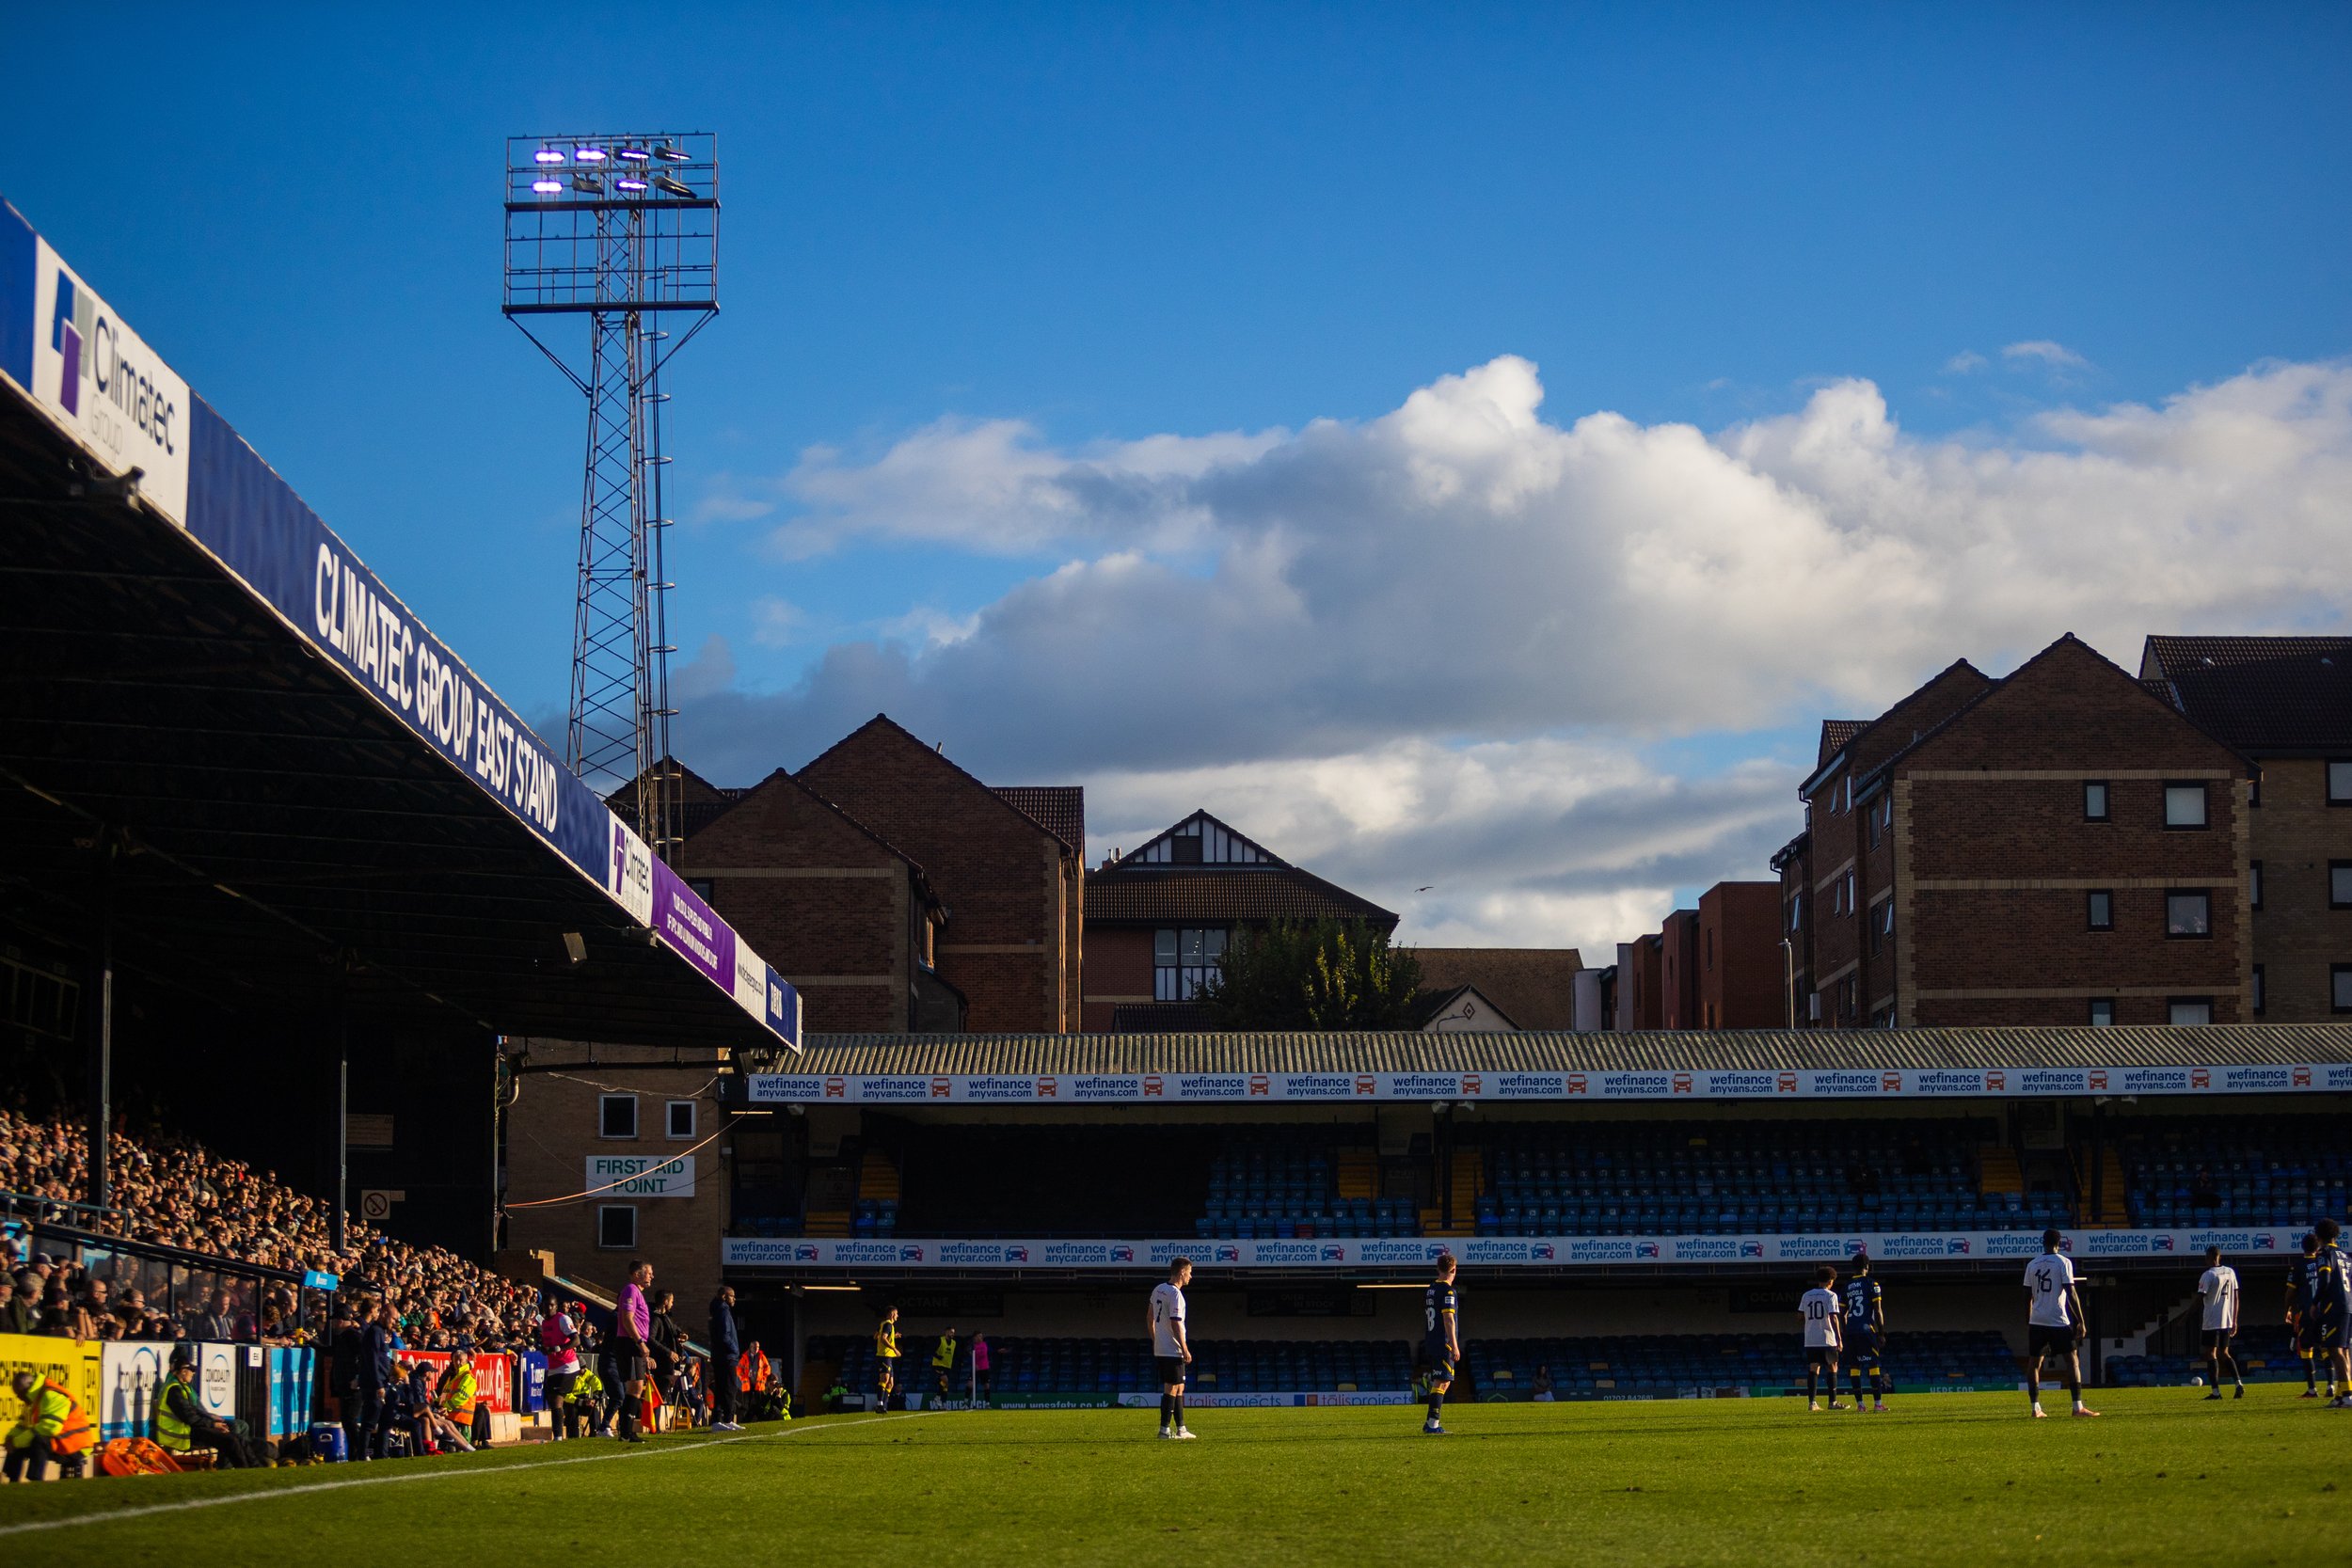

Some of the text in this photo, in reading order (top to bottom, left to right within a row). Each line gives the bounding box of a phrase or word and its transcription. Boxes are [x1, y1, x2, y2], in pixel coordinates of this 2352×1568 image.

[94, 315, 176, 457] Climatec
[315, 543, 559, 833] CLIMATEC GROUP EAST STAND
[1710, 1073, 1772, 1085] wefinance
[1815, 1073, 1877, 1084] wefinance
[1919, 1072, 1980, 1083] wefinance
[2022, 1071, 2084, 1083] wefinance
[2125, 1070, 2185, 1081] wefinance
[2227, 1069, 2287, 1079] wefinance
[757, 1078, 819, 1088] wefinance
[863, 1078, 926, 1089] wefinance
[969, 1078, 1031, 1088] wefinance
[1074, 1077, 1137, 1088] wefinance
[1181, 1076, 1244, 1087] wefinance
[1287, 1076, 1350, 1086] wefinance
[1393, 1075, 1456, 1086] wefinance
[1499, 1075, 1562, 1085] wefinance
[1604, 1074, 1667, 1085] wefinance
[1815, 1085, 1877, 1094] anyvans.com
[1919, 1085, 1980, 1093] anyvans.com
[2022, 1084, 2084, 1092] anyvans.com
[2125, 1083, 2185, 1091] anyvans.com
[2227, 1081, 2287, 1089] anyvans.com
[757, 1090, 819, 1099] anyvans.com
[863, 1091, 926, 1100] anyvans.com
[969, 1090, 1031, 1099] anyvans.com
[1074, 1090, 1137, 1099] anyvans.com
[1181, 1089, 1244, 1098] anyvans.com
[1287, 1088, 1350, 1097] anyvans.com
[1393, 1088, 1456, 1097] anyvans.com
[1499, 1087, 1562, 1096] anyvans.com
[1604, 1086, 1667, 1095] anyvans.com
[596, 1159, 685, 1174] FIRST AID
[612, 1179, 667, 1194] POINT
[1883, 1236, 1943, 1246] wefinance
[2089, 1233, 2148, 1243] wefinance
[2190, 1231, 2249, 1242] wefinance
[731, 1242, 791, 1252] wefinance
[1361, 1242, 1422, 1252] wefinance
[1467, 1241, 1527, 1251] wefinance
[1571, 1240, 1632, 1250] wefinance
[1677, 1239, 1736, 1249] wefinance
[1780, 1237, 1840, 1248] wefinance
[835, 1243, 896, 1253] wefinance
[940, 1243, 1001, 1253] wefinance
[1045, 1243, 1106, 1254] wefinance
[1151, 1243, 1212, 1253] wefinance
[1256, 1243, 1317, 1253] wefinance
[1883, 1247, 1943, 1257] anycar.com
[2089, 1244, 2148, 1254] anycar.com
[731, 1253, 791, 1262] anycar.com
[835, 1254, 896, 1263] anycar.com
[1256, 1254, 1317, 1263] anycar.com
[1361, 1253, 1422, 1262] anycar.com
[1467, 1253, 1527, 1261] anycar.com
[1571, 1251, 1632, 1260] anycar.com
[1677, 1250, 1736, 1259] anycar.com
[1780, 1249, 1840, 1259] anycar.com
[940, 1255, 1001, 1264] anycar.com
[1045, 1255, 1106, 1264] anycar.com
[2034, 1268, 2053, 1294] 16
[1155, 1299, 1163, 1323] 7
[1807, 1300, 1825, 1321] 10
